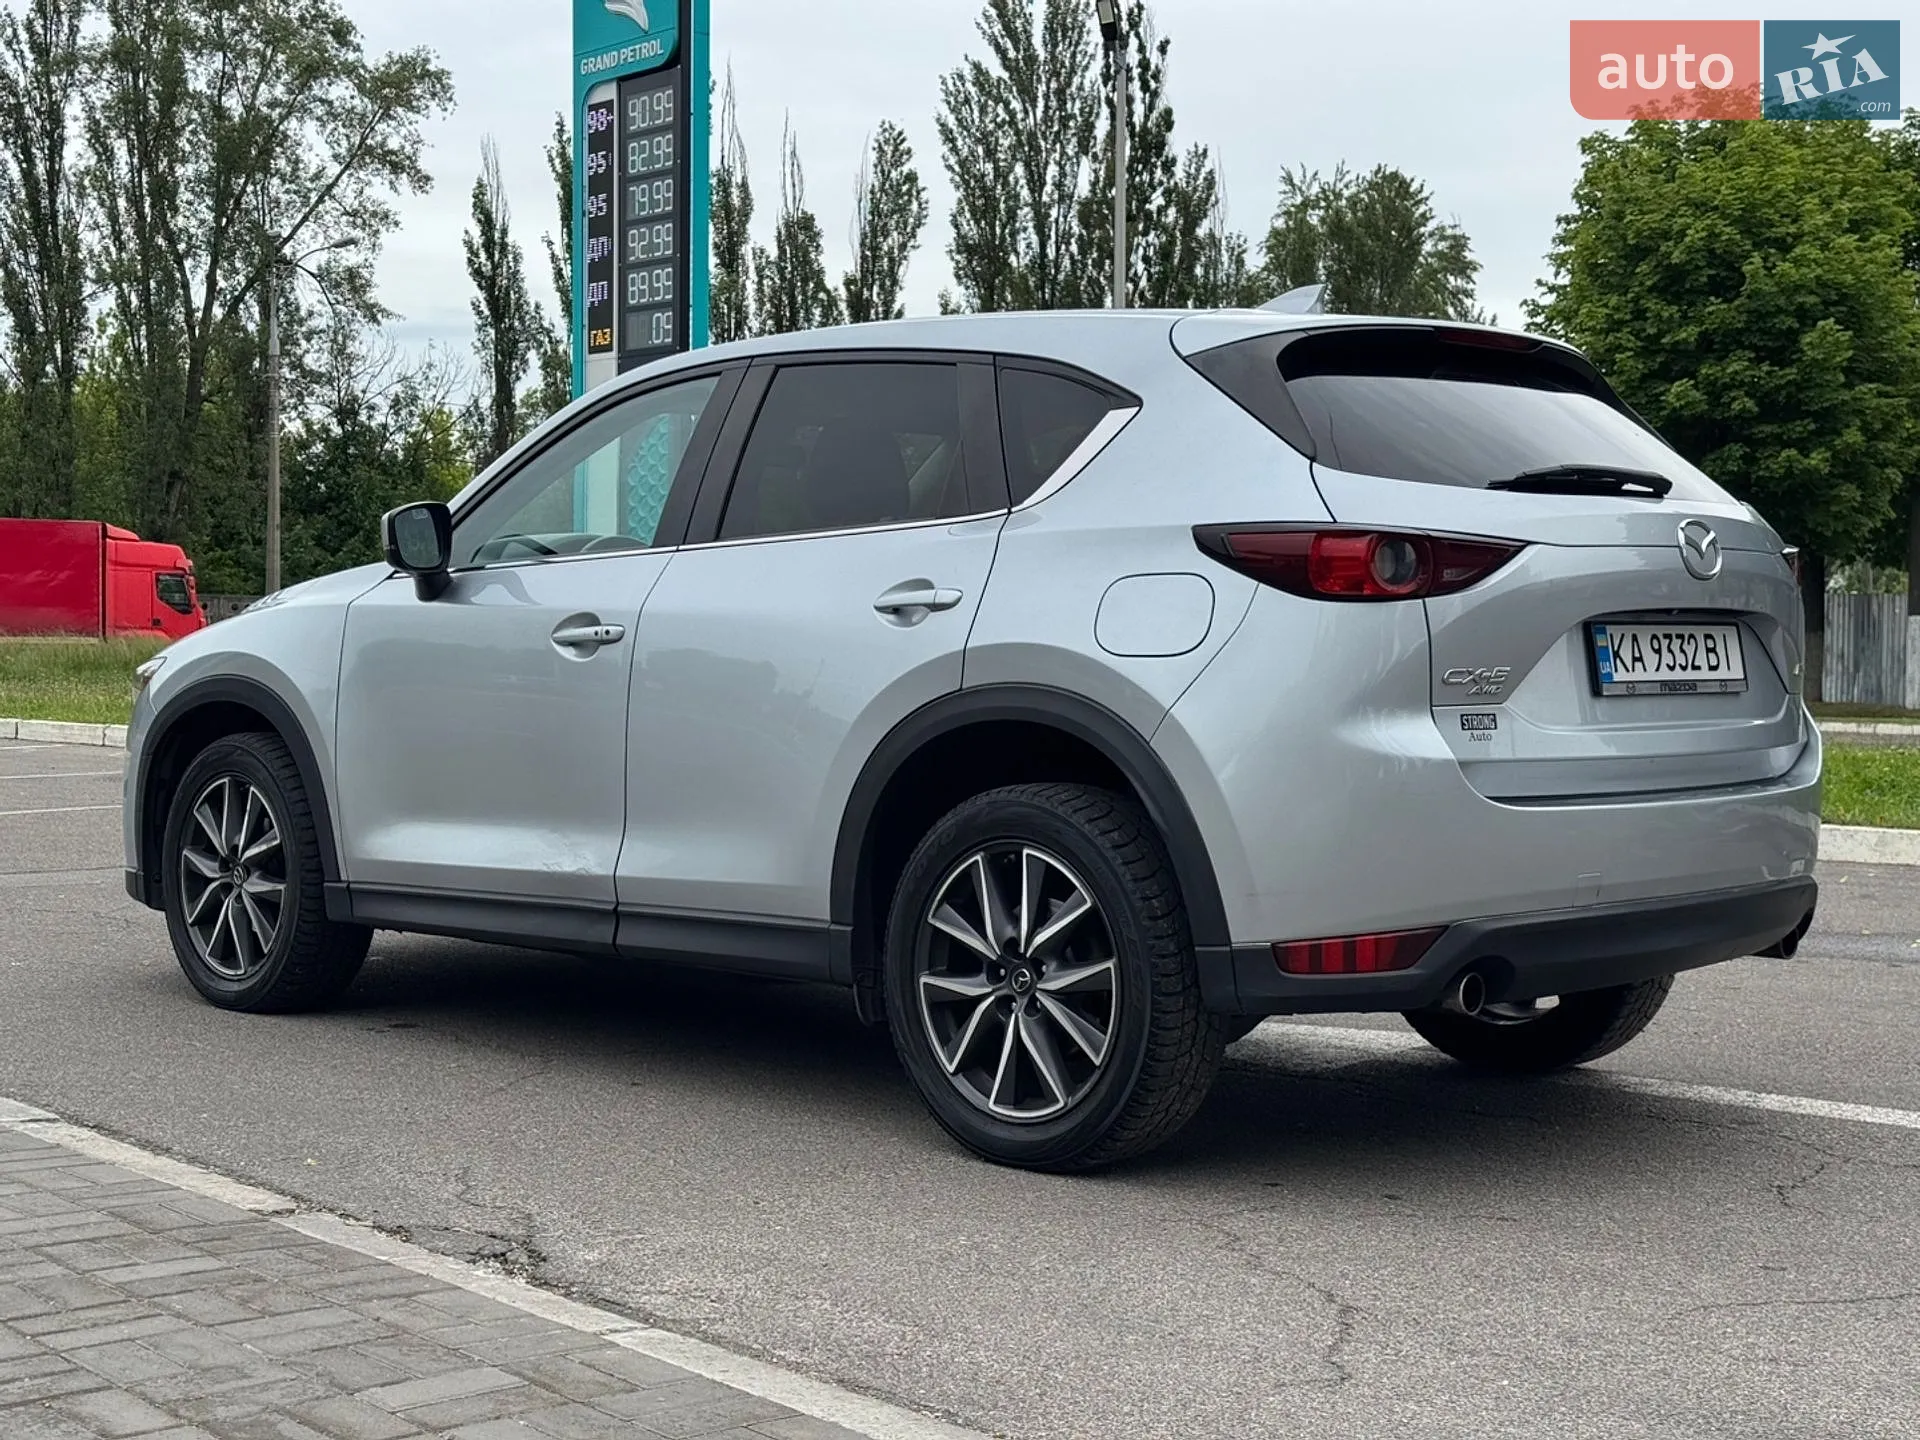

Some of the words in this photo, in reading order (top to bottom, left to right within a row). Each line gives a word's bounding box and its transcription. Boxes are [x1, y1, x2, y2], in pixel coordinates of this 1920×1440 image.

[580, 53, 618, 75] GRAND
[620, 39, 664, 63] PETROL
[629, 89, 673, 130] 90.99
[628, 134, 673, 173] 82.99
[588, 194, 607, 217] 95
[629, 179, 673, 216] 79.99
[628, 223, 673, 260] 92.99
[628, 268, 673, 304] 89.99
[590, 328, 612, 347] ГАЗ
[1600, 661, 1612, 674] UA
[1650, 633, 1701, 673] 9332
[1461, 714, 1496, 730] STRONG
[1468, 731, 1493, 742] Auto
